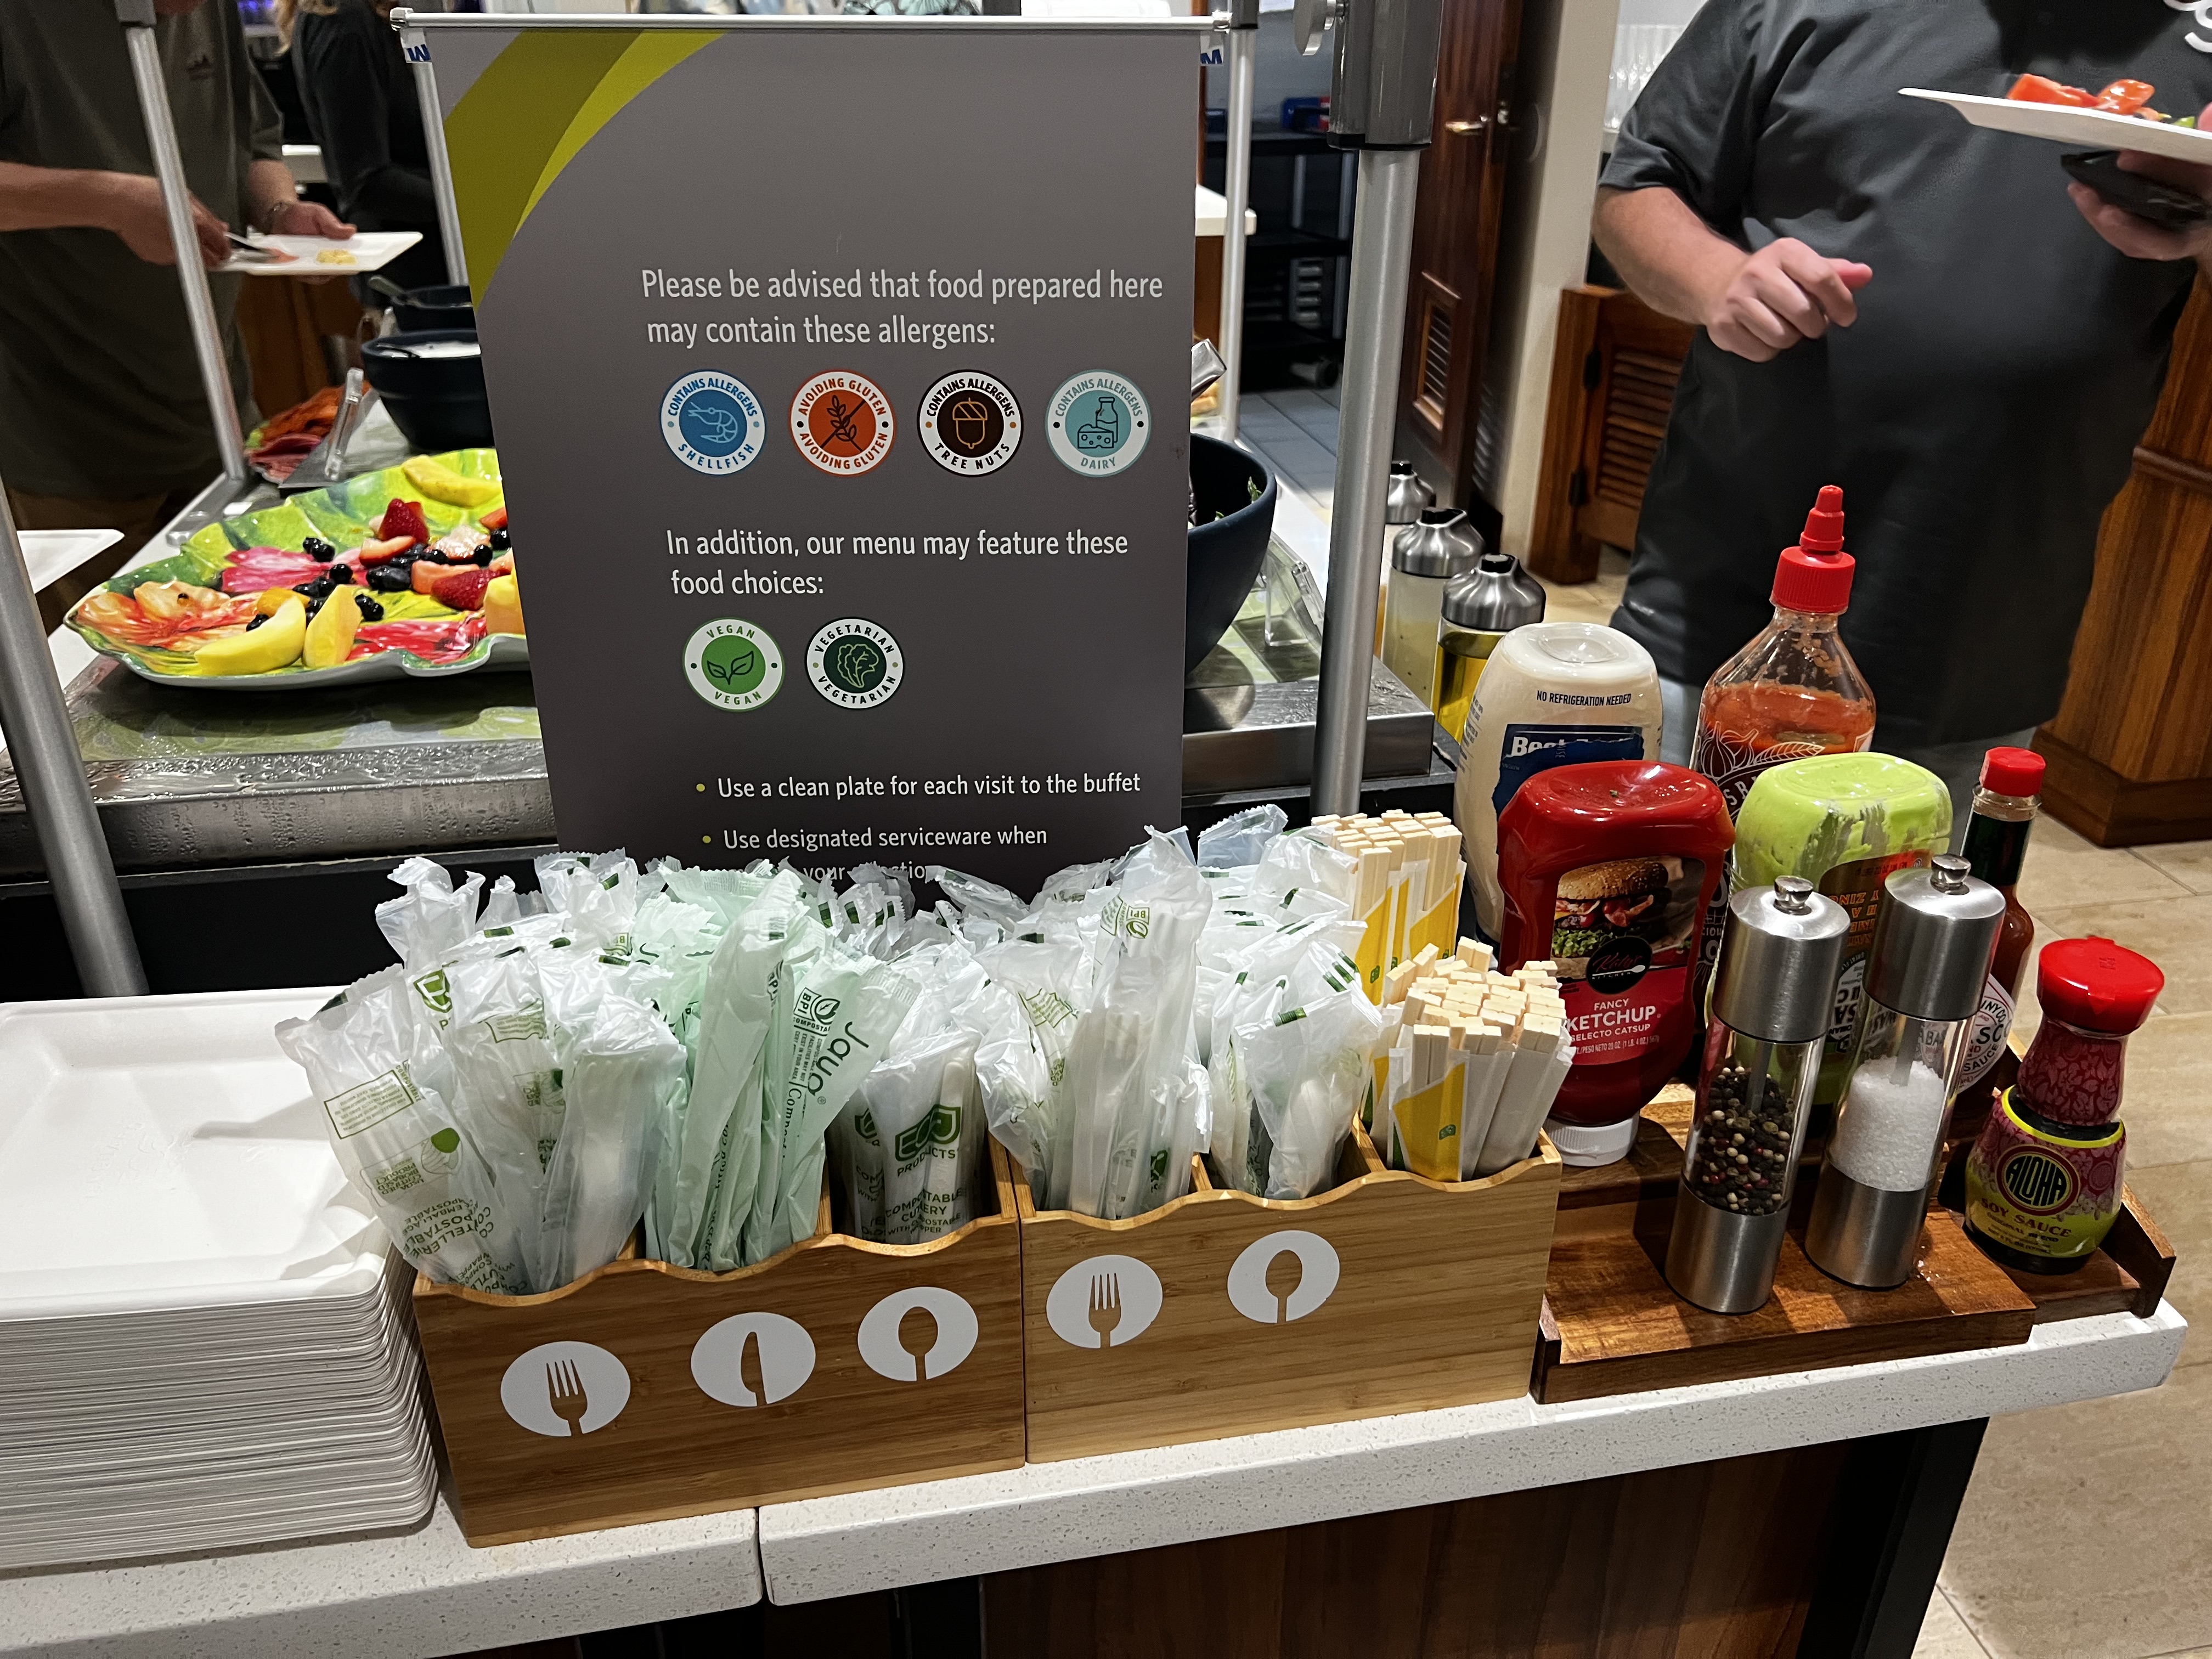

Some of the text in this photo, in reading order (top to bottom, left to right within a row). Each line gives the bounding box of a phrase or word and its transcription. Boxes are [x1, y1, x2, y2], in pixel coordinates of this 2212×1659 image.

[642, 268, 1163, 305] Please be advised that food prepared here
[647, 314, 995, 349] may contain these allergens:
[668, 377, 757, 417] CONTAINS ALLERGENS
[798, 378, 886, 416] AVOIDING GLUTEN
[927, 378, 1015, 417] CONTAINS ALLERGENS
[1056, 378, 1143, 417] CONTAINS ALLERGENS
[679, 443, 754, 469] SHELLFISH
[800, 433, 888, 469] AVOIDING GLUTEN
[934, 442, 1010, 469] TREE NUTS
[1081, 456, 1116, 469] DAIRY
[667, 529, 1127, 560] In addition, our menu may feature these
[671, 569, 823, 594] food choices:
[706, 625, 755, 639] VEGAN
[814, 624, 894, 653] VEGETARIAN
[714, 691, 762, 705] VEGAN
[818, 675, 896, 704] VEGETARIAN
[1537, 690, 1632, 706] NO REFRIGERATION NEEDED
[718, 772, 1141, 800] Use a clean plate for each visit to the buffet
[724, 825, 1047, 852] Use designated serviceware when
[1131, 910, 1146, 918] BPI
[797, 992, 811, 1014] BPI
[1594, 998, 1629, 1011] FANCY
[1567, 1006, 1656, 1032] KETCHUP
[1571, 1023, 1651, 1042] SELECTO CATSUP
[1576, 1045, 1594, 1054] T./PESO
[1963, 1043, 1999, 1071] SAUCE
[376, 1163, 416, 1184] PRODUCT
[2006, 1155, 2067, 1206] ALOHA
[885, 1187, 962, 1218] COMPOTABLE
[1982, 1198, 2072, 1237] SOY SAUCE
[411, 1221, 494, 1259] COTELLERIE
